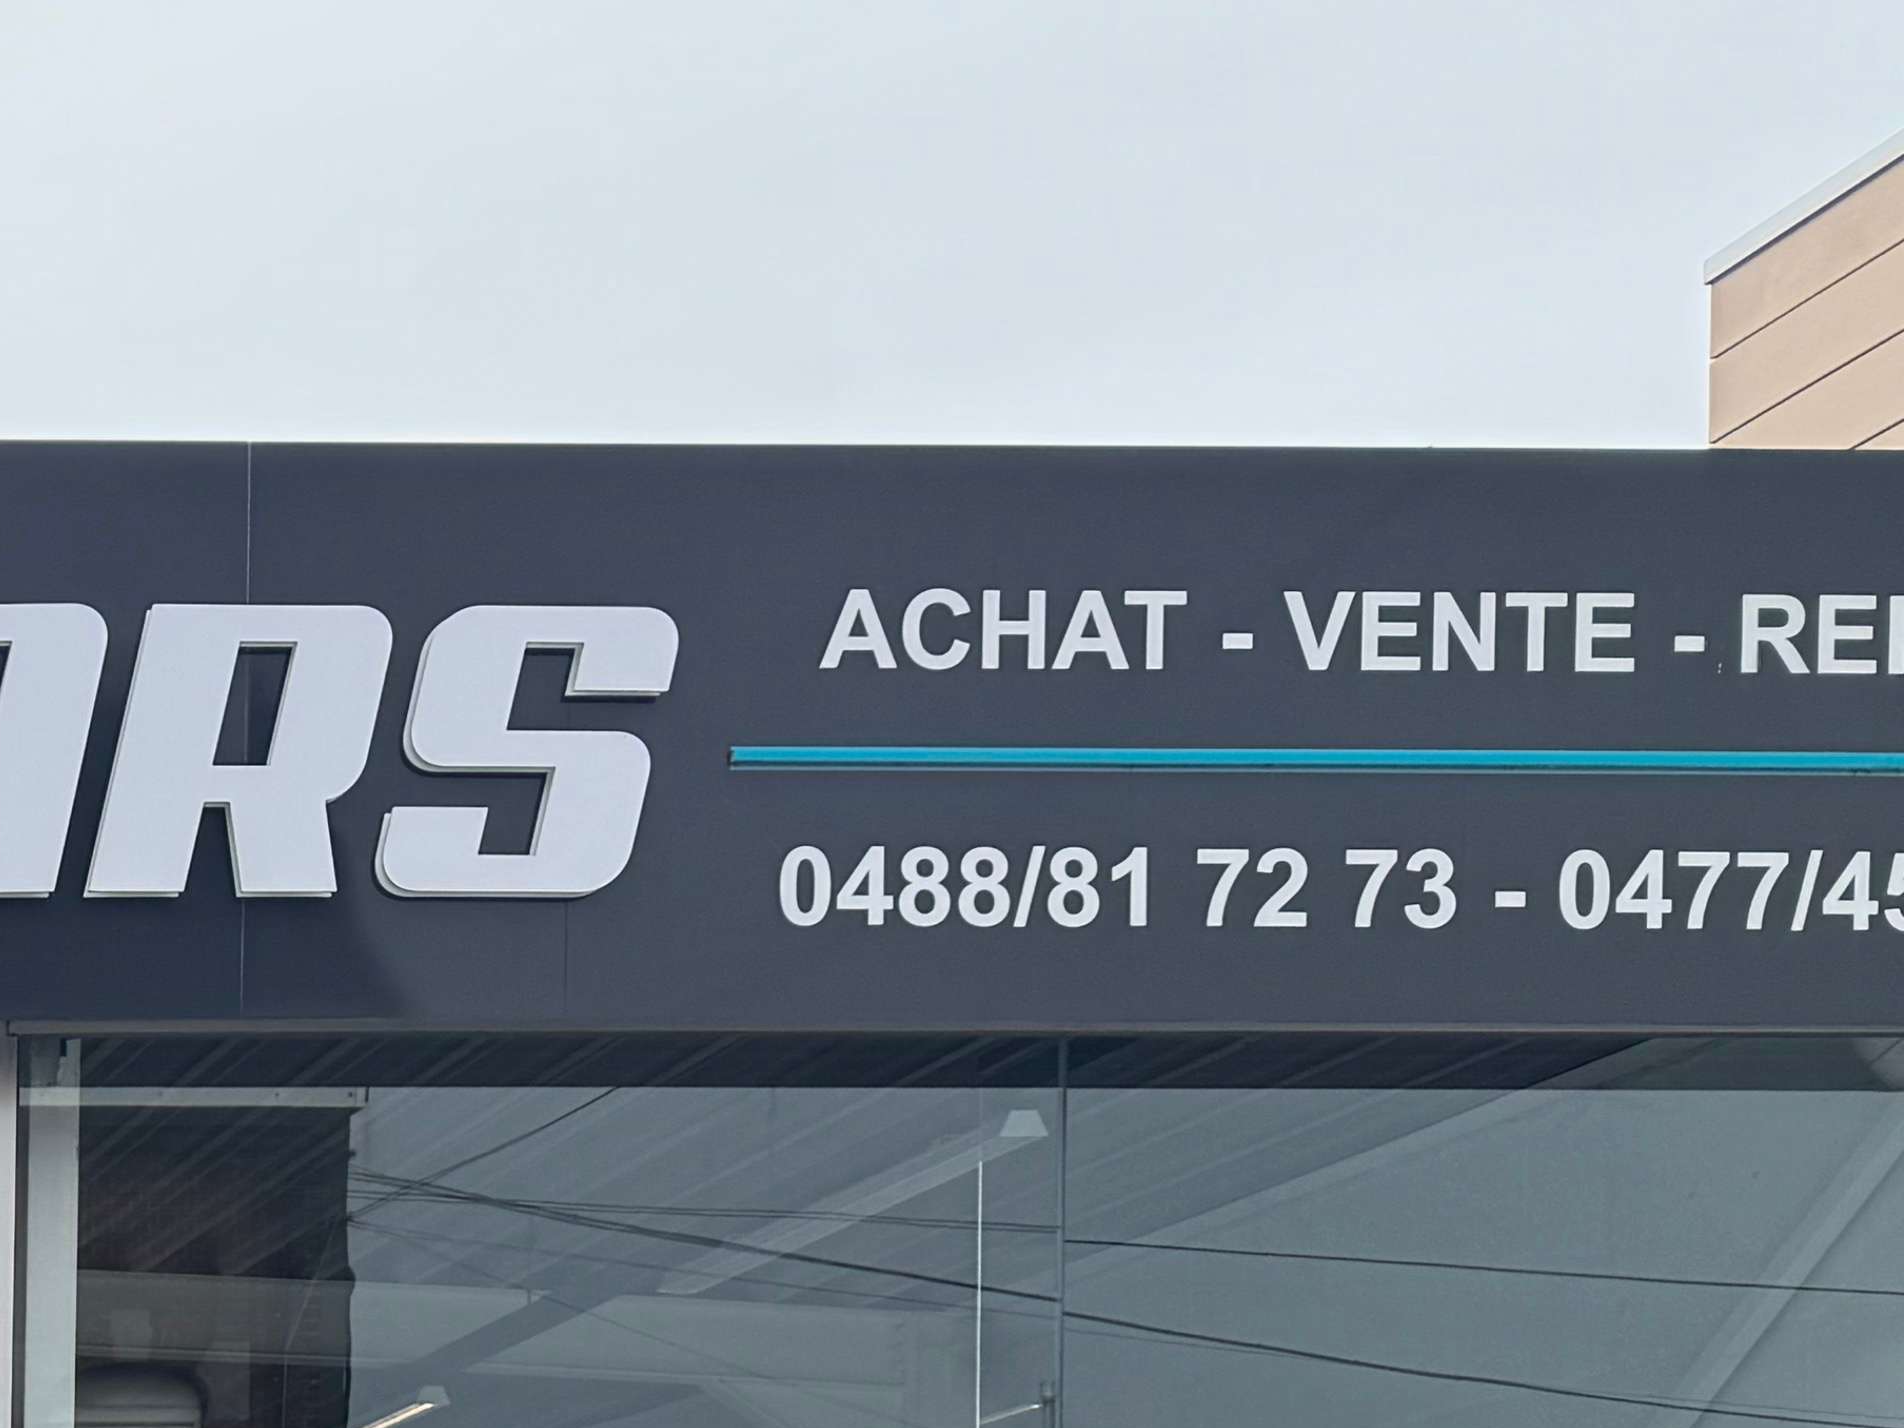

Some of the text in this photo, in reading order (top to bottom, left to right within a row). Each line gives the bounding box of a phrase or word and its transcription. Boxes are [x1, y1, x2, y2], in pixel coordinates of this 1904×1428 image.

[819, 588, 1188, 671] ACHAT
[1222, 632, 1254, 650] -
[1283, 590, 1636, 673] VENTE
[1673, 635, 1705, 653] -
[779, 845, 1149, 928] 0488/81
[1196, 847, 1309, 928] 72
[1345, 848, 1457, 929] 73
[1494, 891, 1527, 908] -
